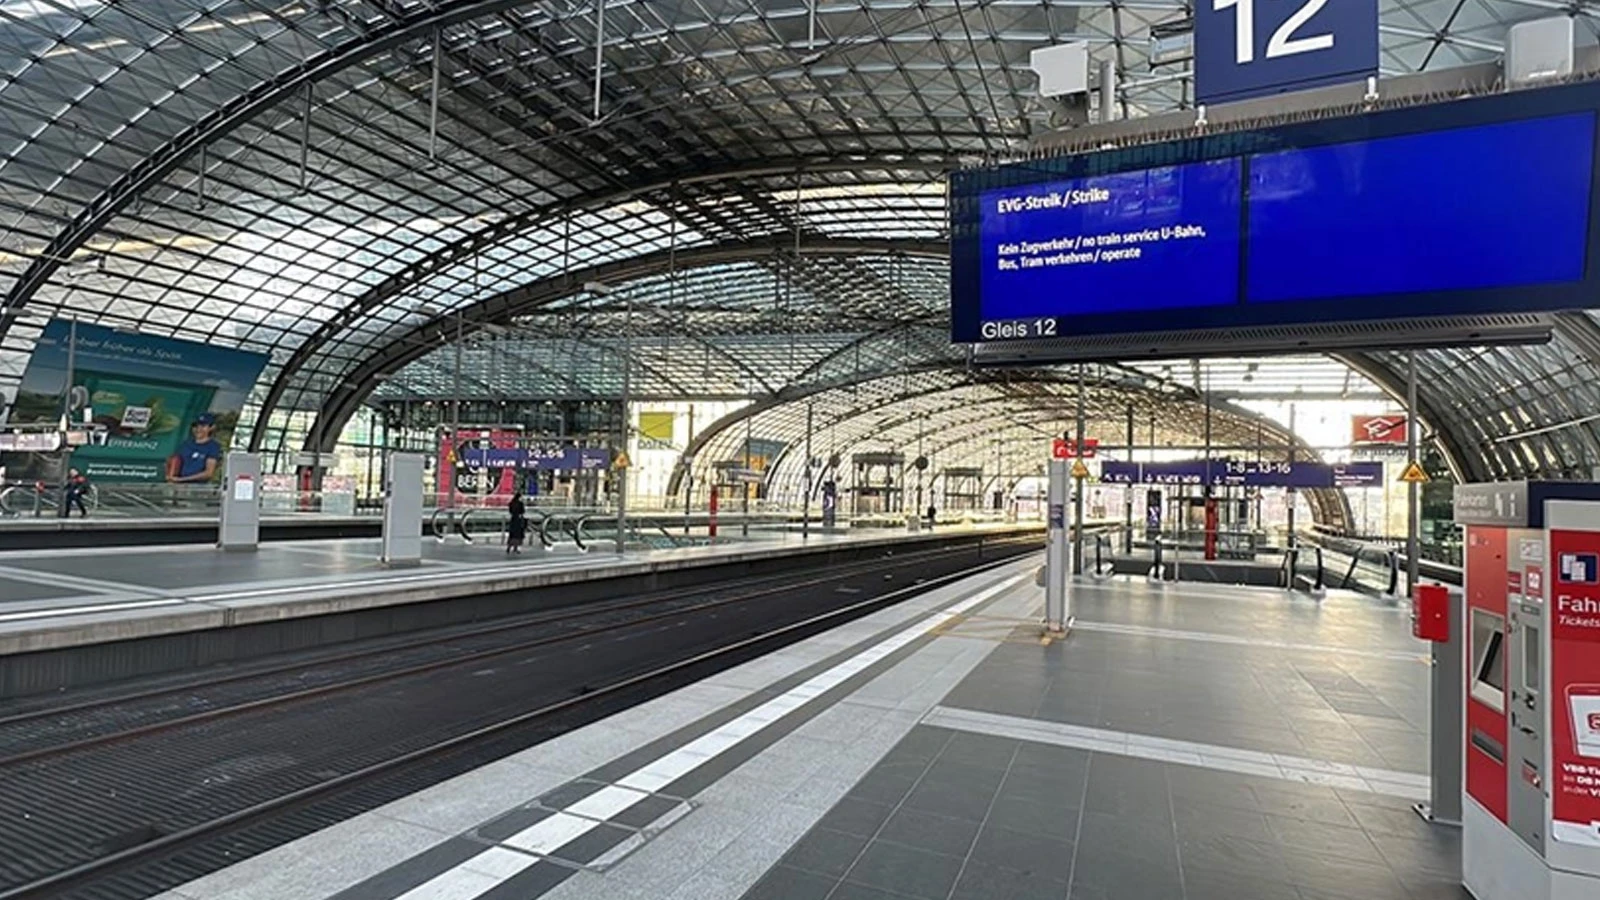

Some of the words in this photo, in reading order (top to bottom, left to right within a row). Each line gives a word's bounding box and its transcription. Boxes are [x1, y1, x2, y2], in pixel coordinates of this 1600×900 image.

[1213, 0, 1334, 64] 12
[998, 193, 1062, 214] EVG-Streik
[1062, 188, 1071, 208] /
[1072, 188, 1110, 205] Strike
[998, 243, 1019, 255] Kein
[1021, 238, 1074, 255] Zugverkehr
[1074, 235, 1082, 250] /
[1082, 236, 1095, 247] no
[1097, 233, 1121, 246] train
[1123, 229, 1160, 243] service
[1161, 224, 1206, 240] U-Bahn,
[998, 258, 1019, 270] Bus,
[1020, 256, 1044, 268] Tram
[1045, 252, 1093, 266] verkehren
[1093, 249, 1101, 263] /
[1101, 247, 1141, 263] operate
[981, 320, 1027, 339] Gleis
[1033, 318, 1057, 336] 12
[1558, 595, 1600, 613] Fah
